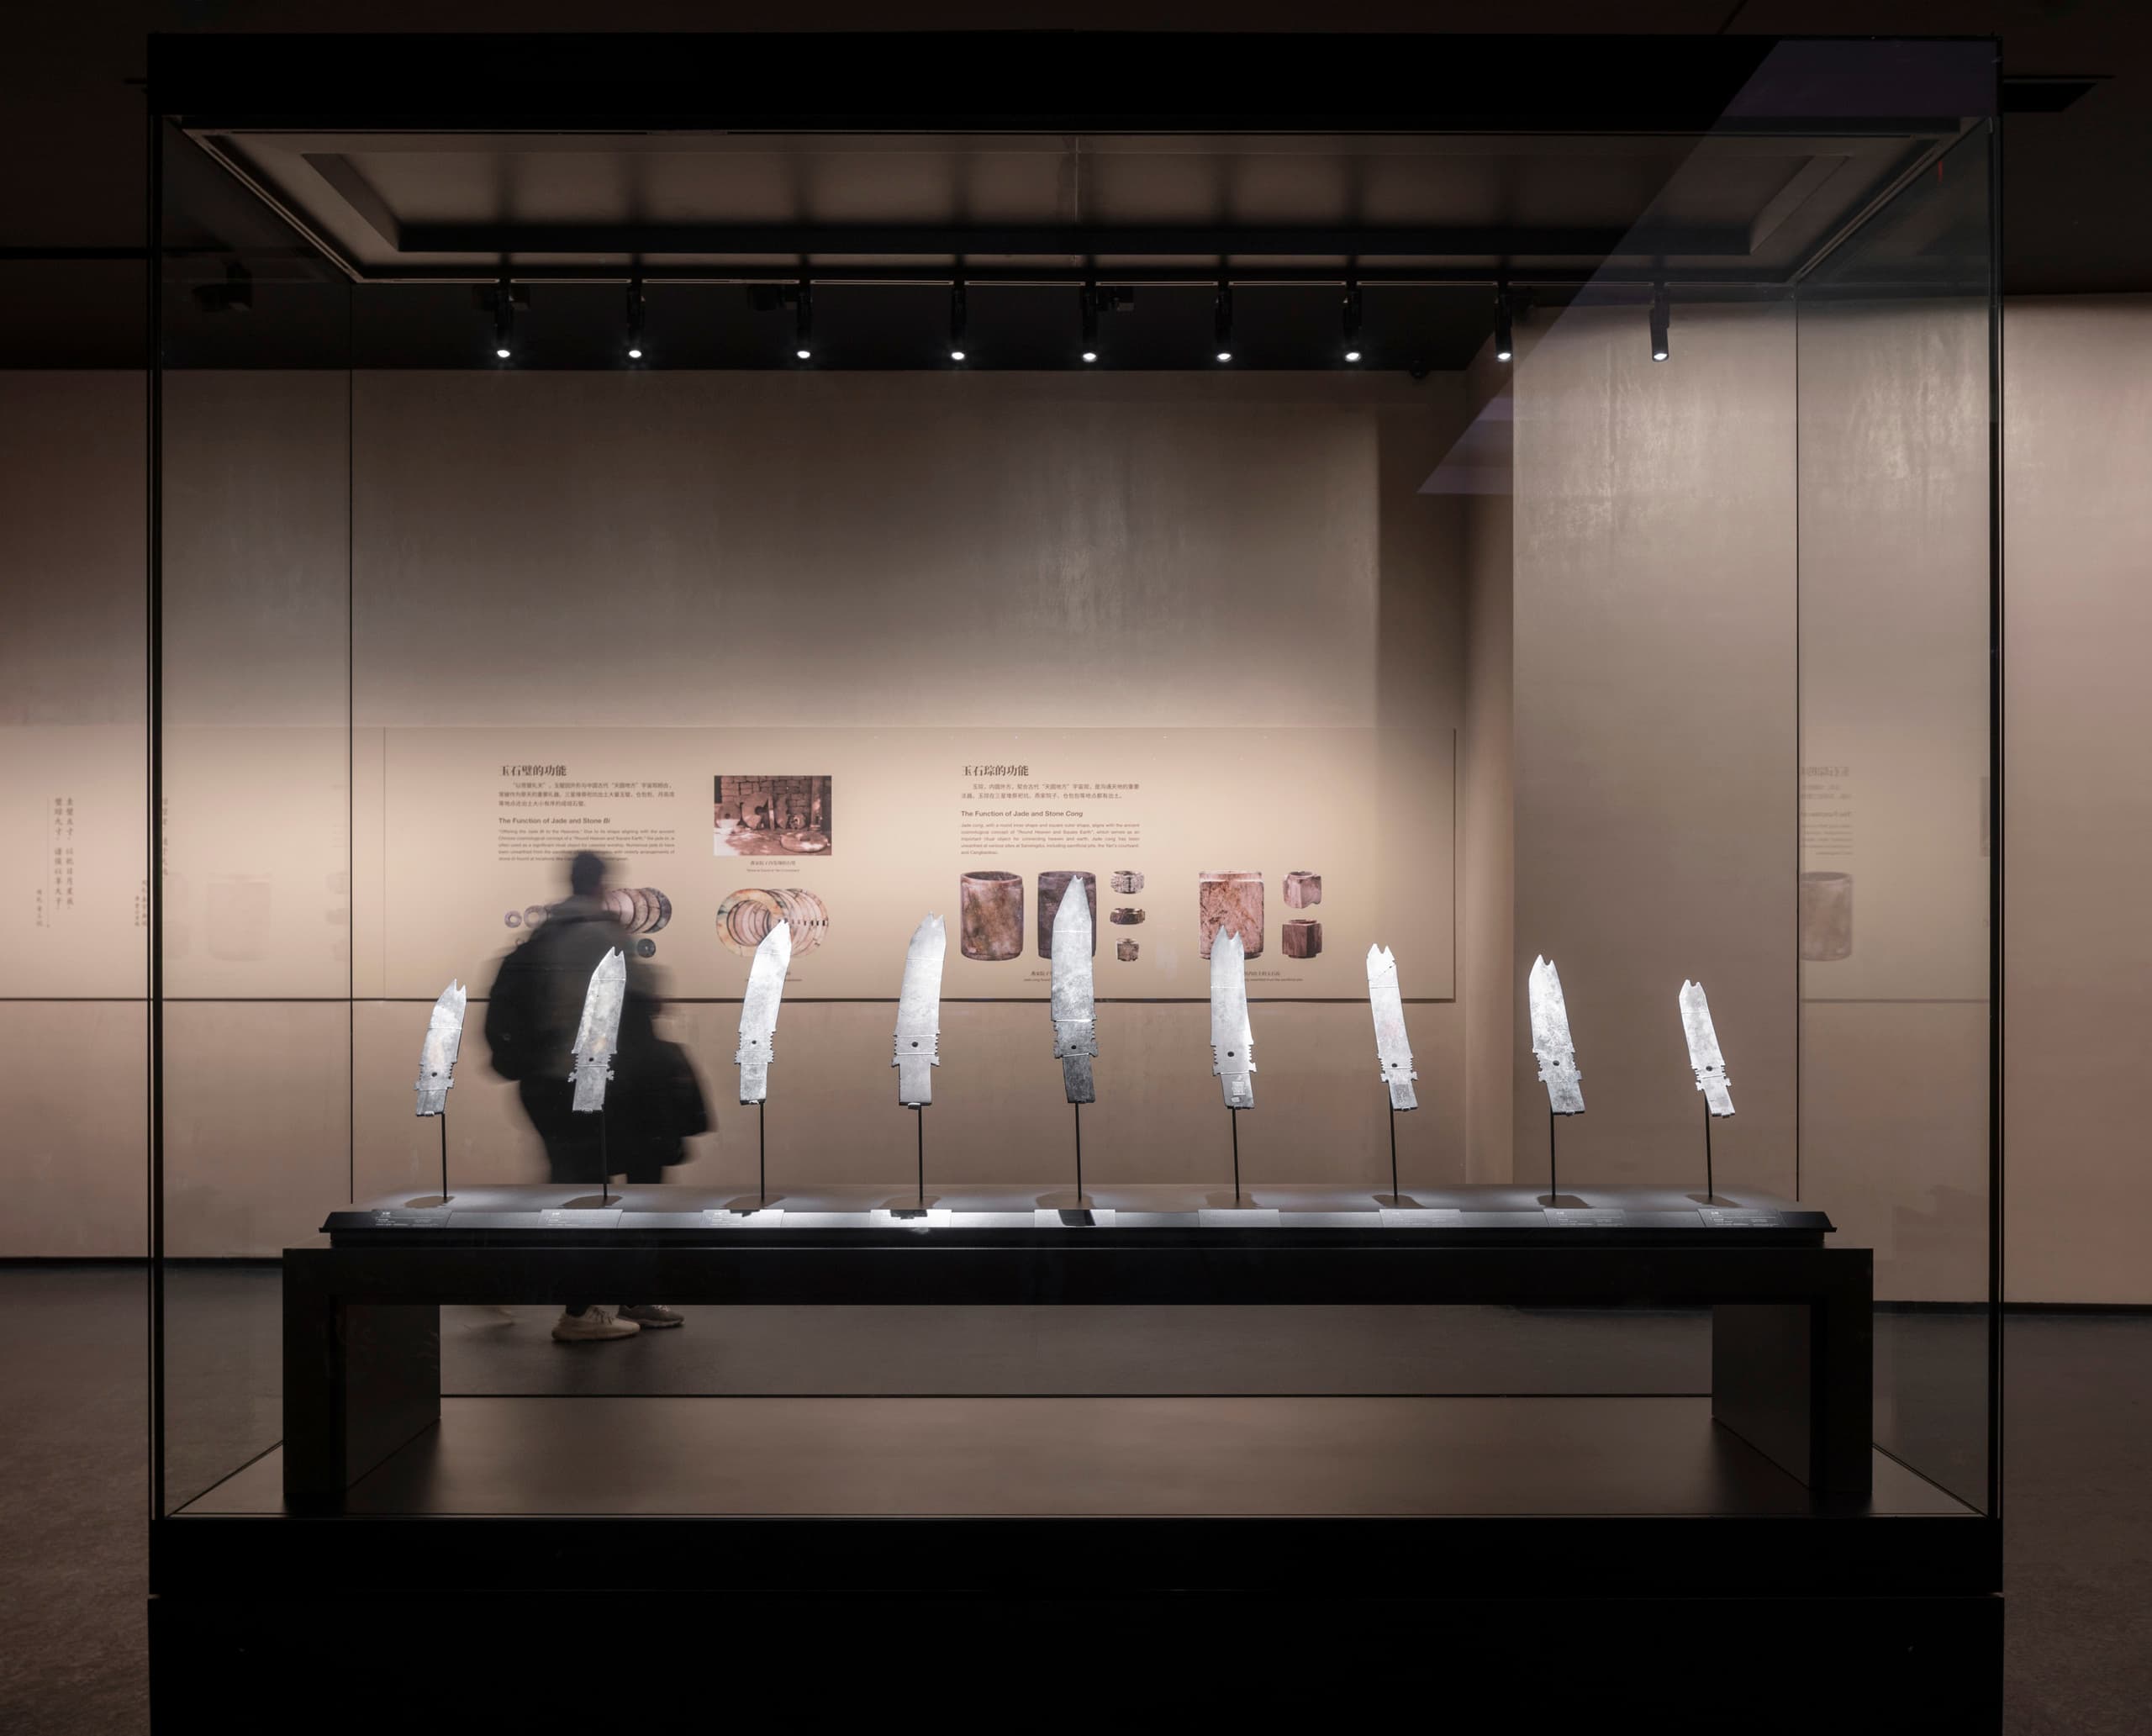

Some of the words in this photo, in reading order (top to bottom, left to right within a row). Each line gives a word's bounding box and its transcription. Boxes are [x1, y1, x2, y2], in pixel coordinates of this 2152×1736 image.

[499, 764, 567, 777] 玉石璧的功能
[962, 764, 1029, 777] 玉石琮的功能
